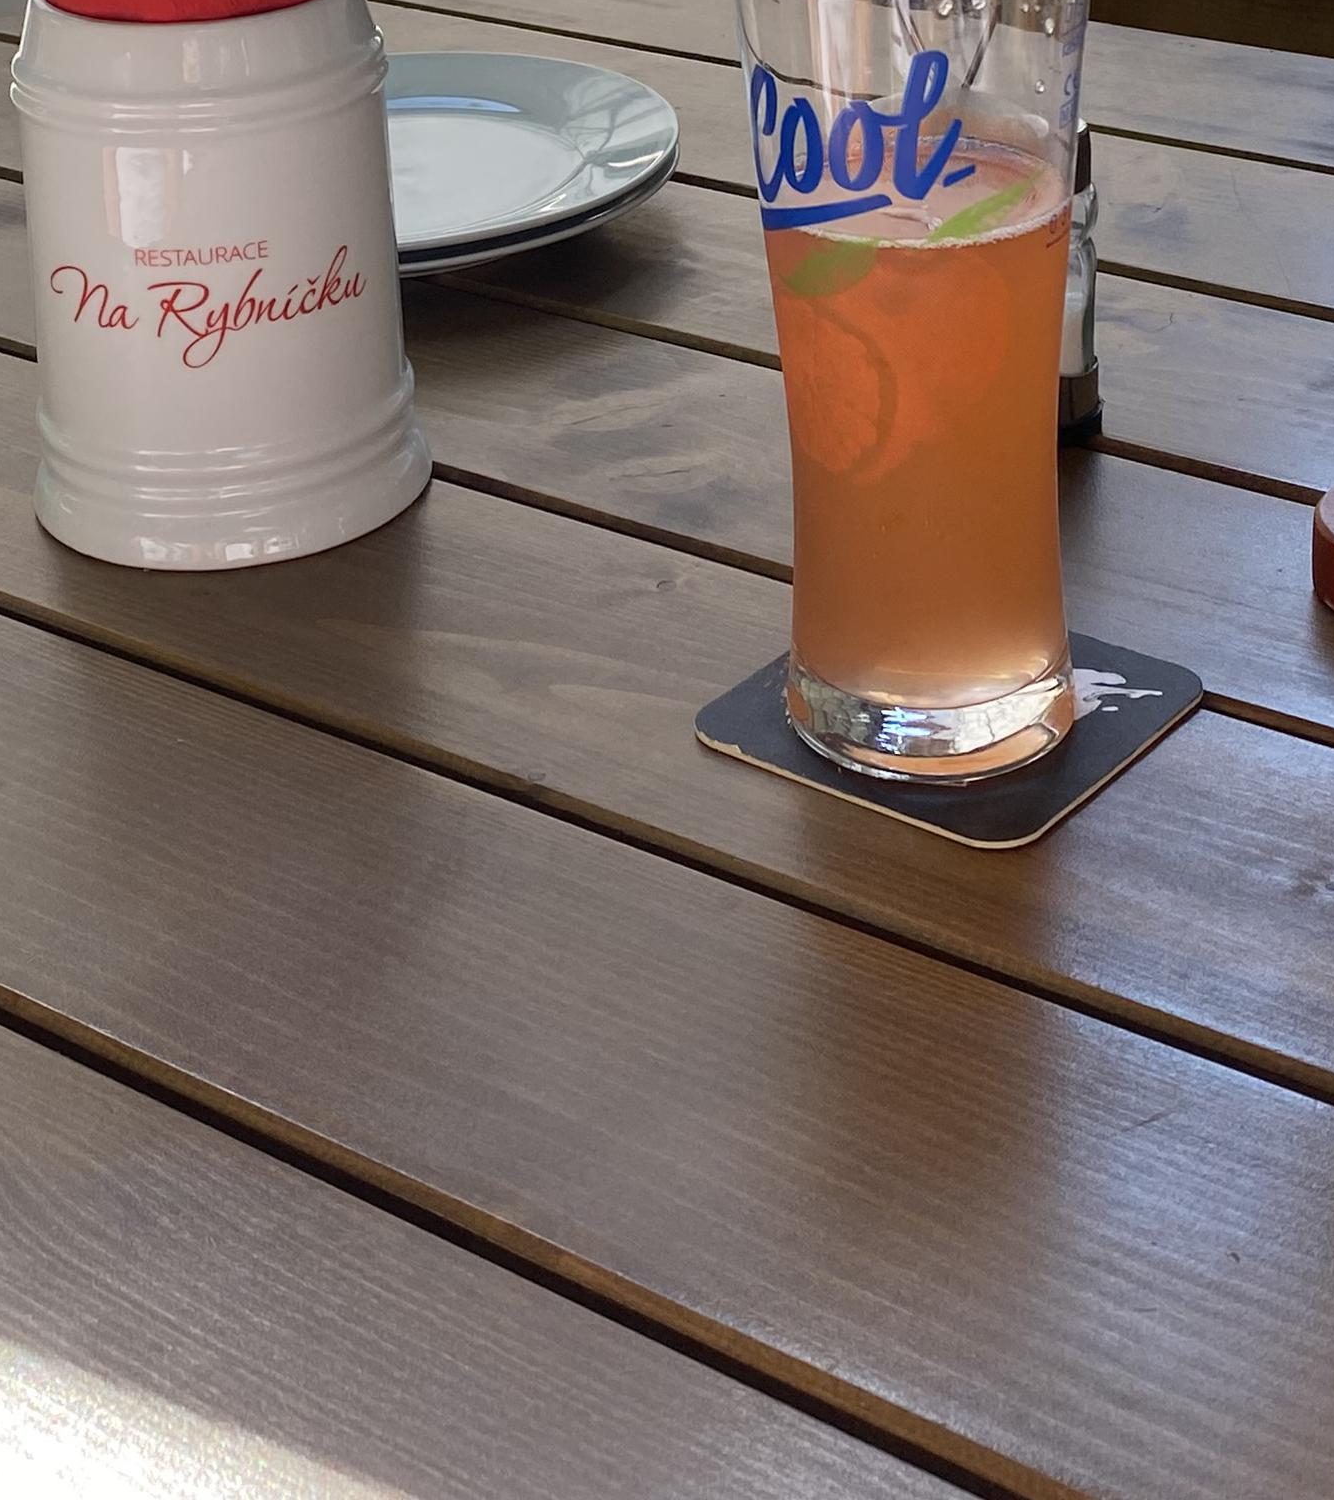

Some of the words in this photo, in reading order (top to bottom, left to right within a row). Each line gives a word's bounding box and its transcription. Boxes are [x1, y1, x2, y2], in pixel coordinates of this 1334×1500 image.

[750, 50, 963, 204] Cool
[49, 265, 140, 330] Na
[146, 244, 368, 369] Rybníčku
[134, 239, 270, 268] RESTAURACE
